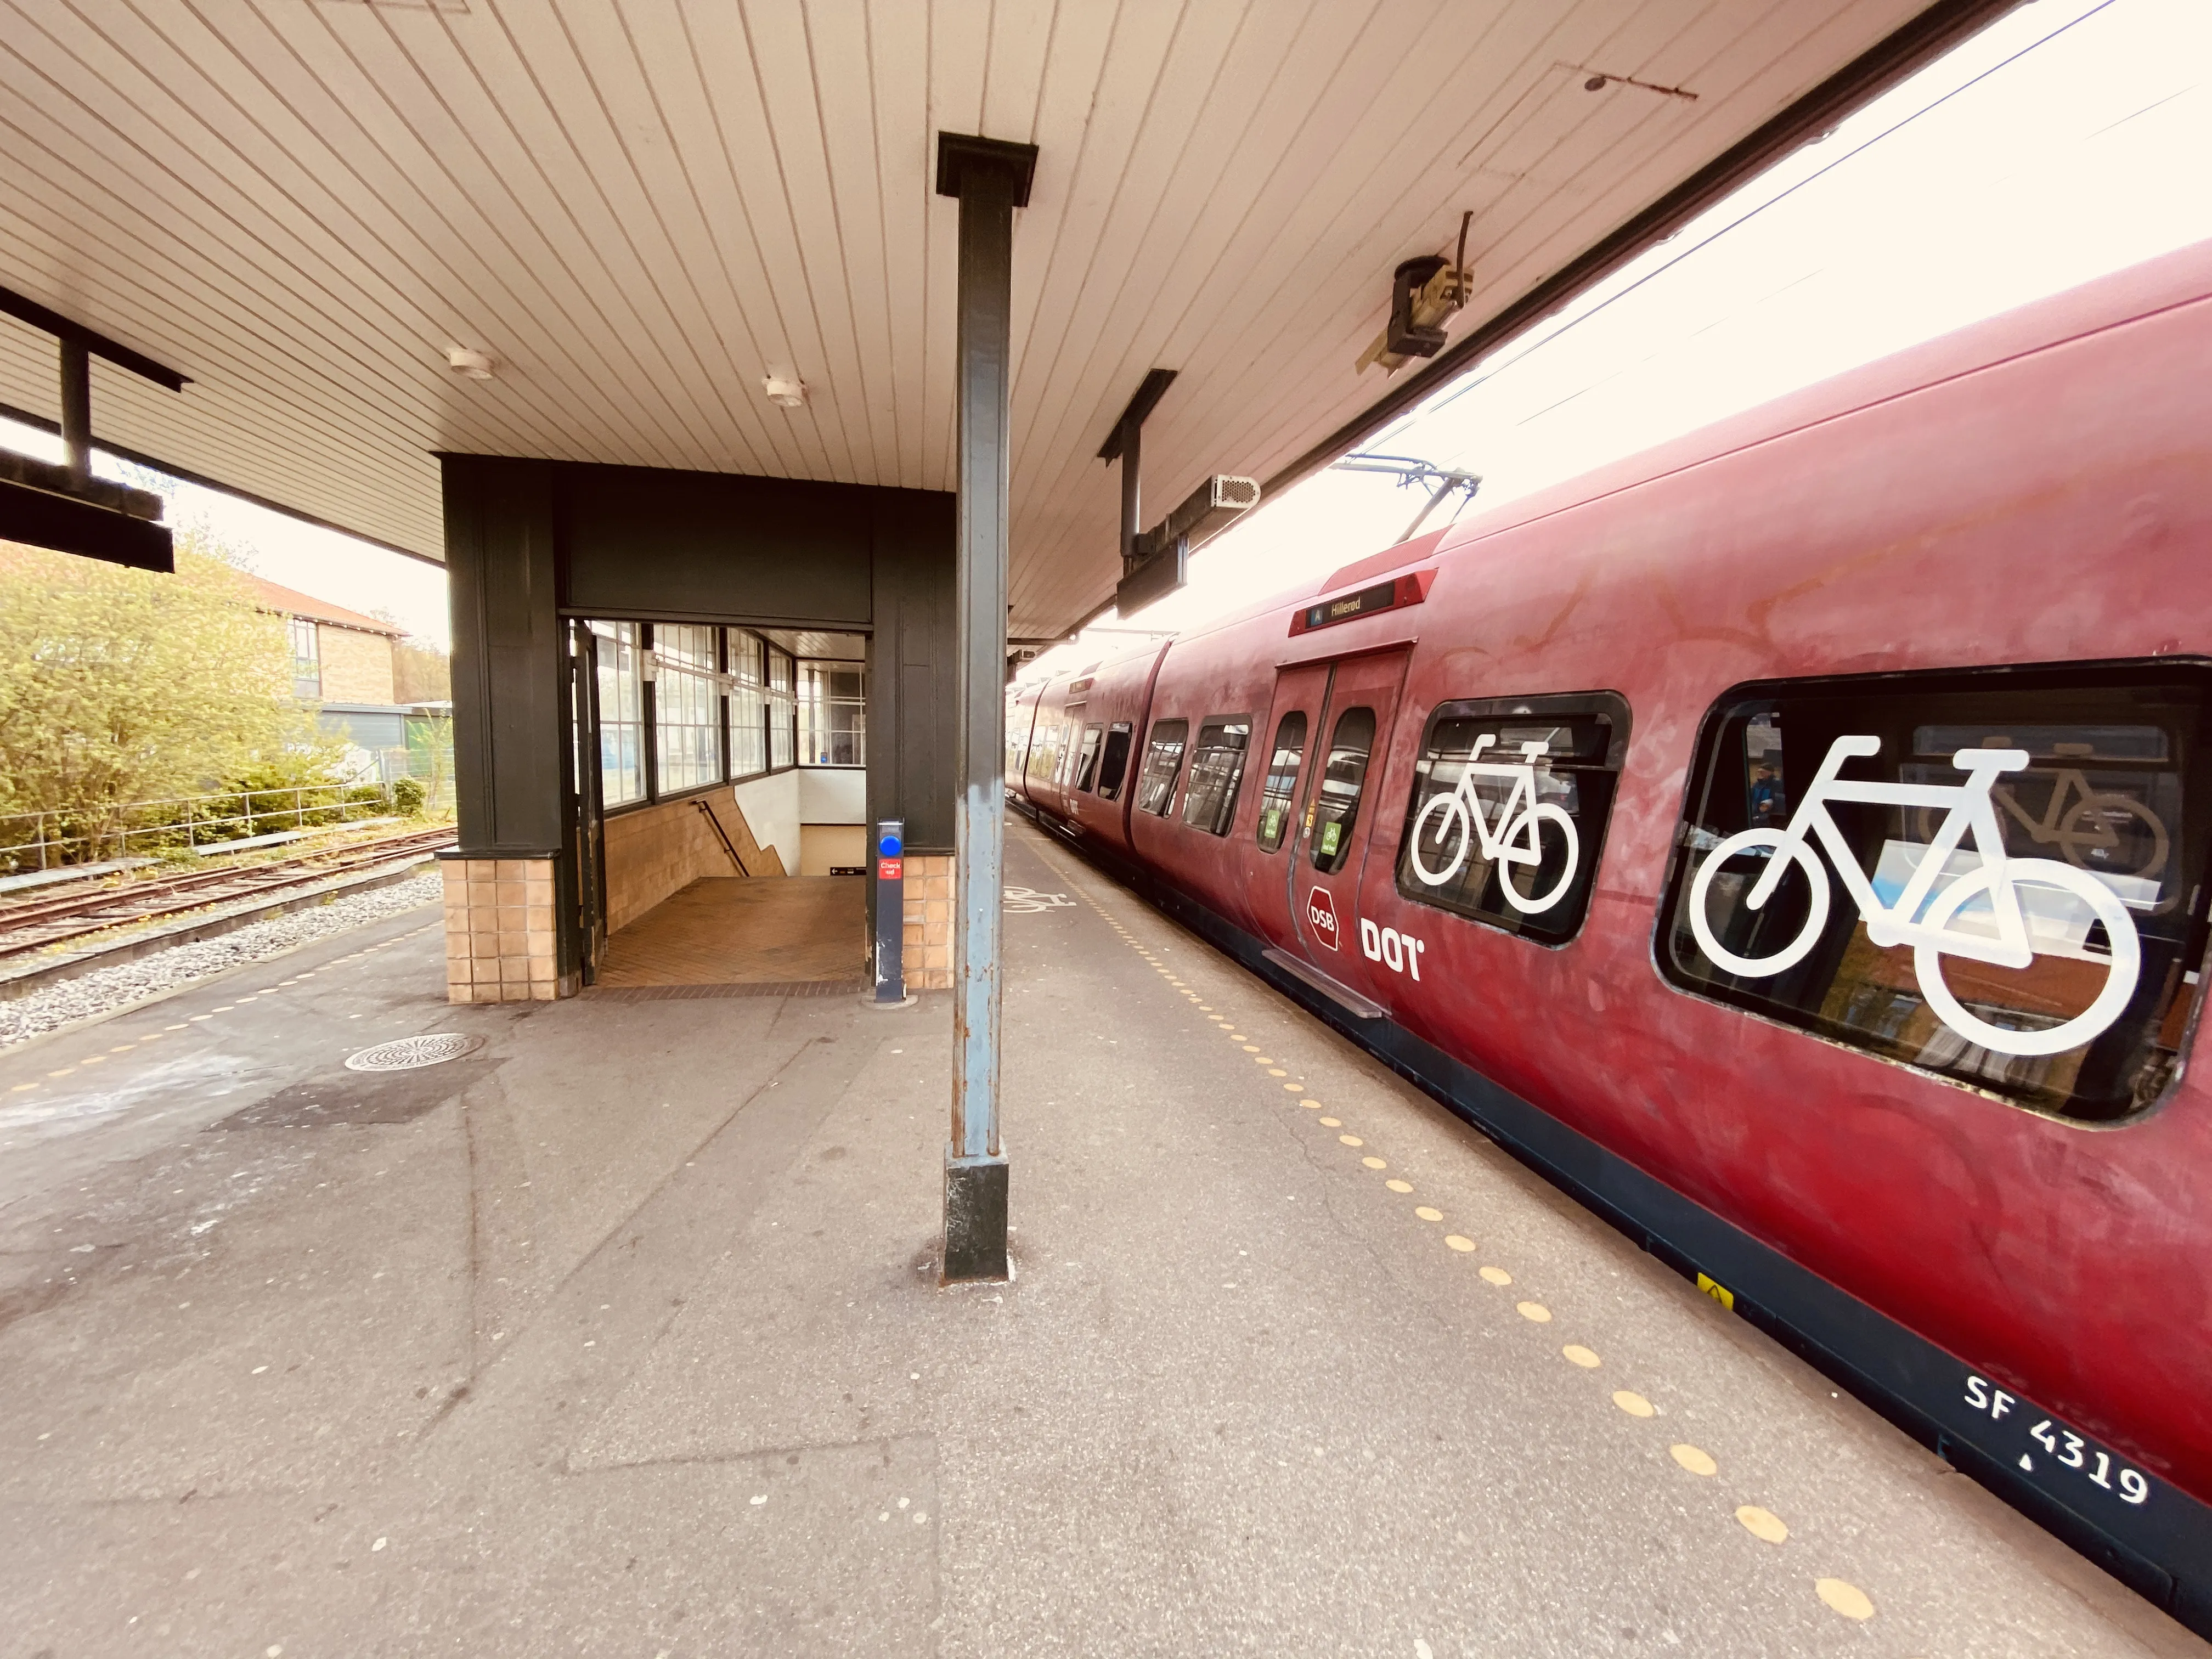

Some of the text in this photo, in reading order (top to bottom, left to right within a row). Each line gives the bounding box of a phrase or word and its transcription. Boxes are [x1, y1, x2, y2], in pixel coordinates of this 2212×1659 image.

[1314, 610, 1321, 622] A
[1310, 906, 1335, 932] DSB
[1361, 917, 1425, 982] DOT
[1963, 1375, 2148, 1505] SF 4319
